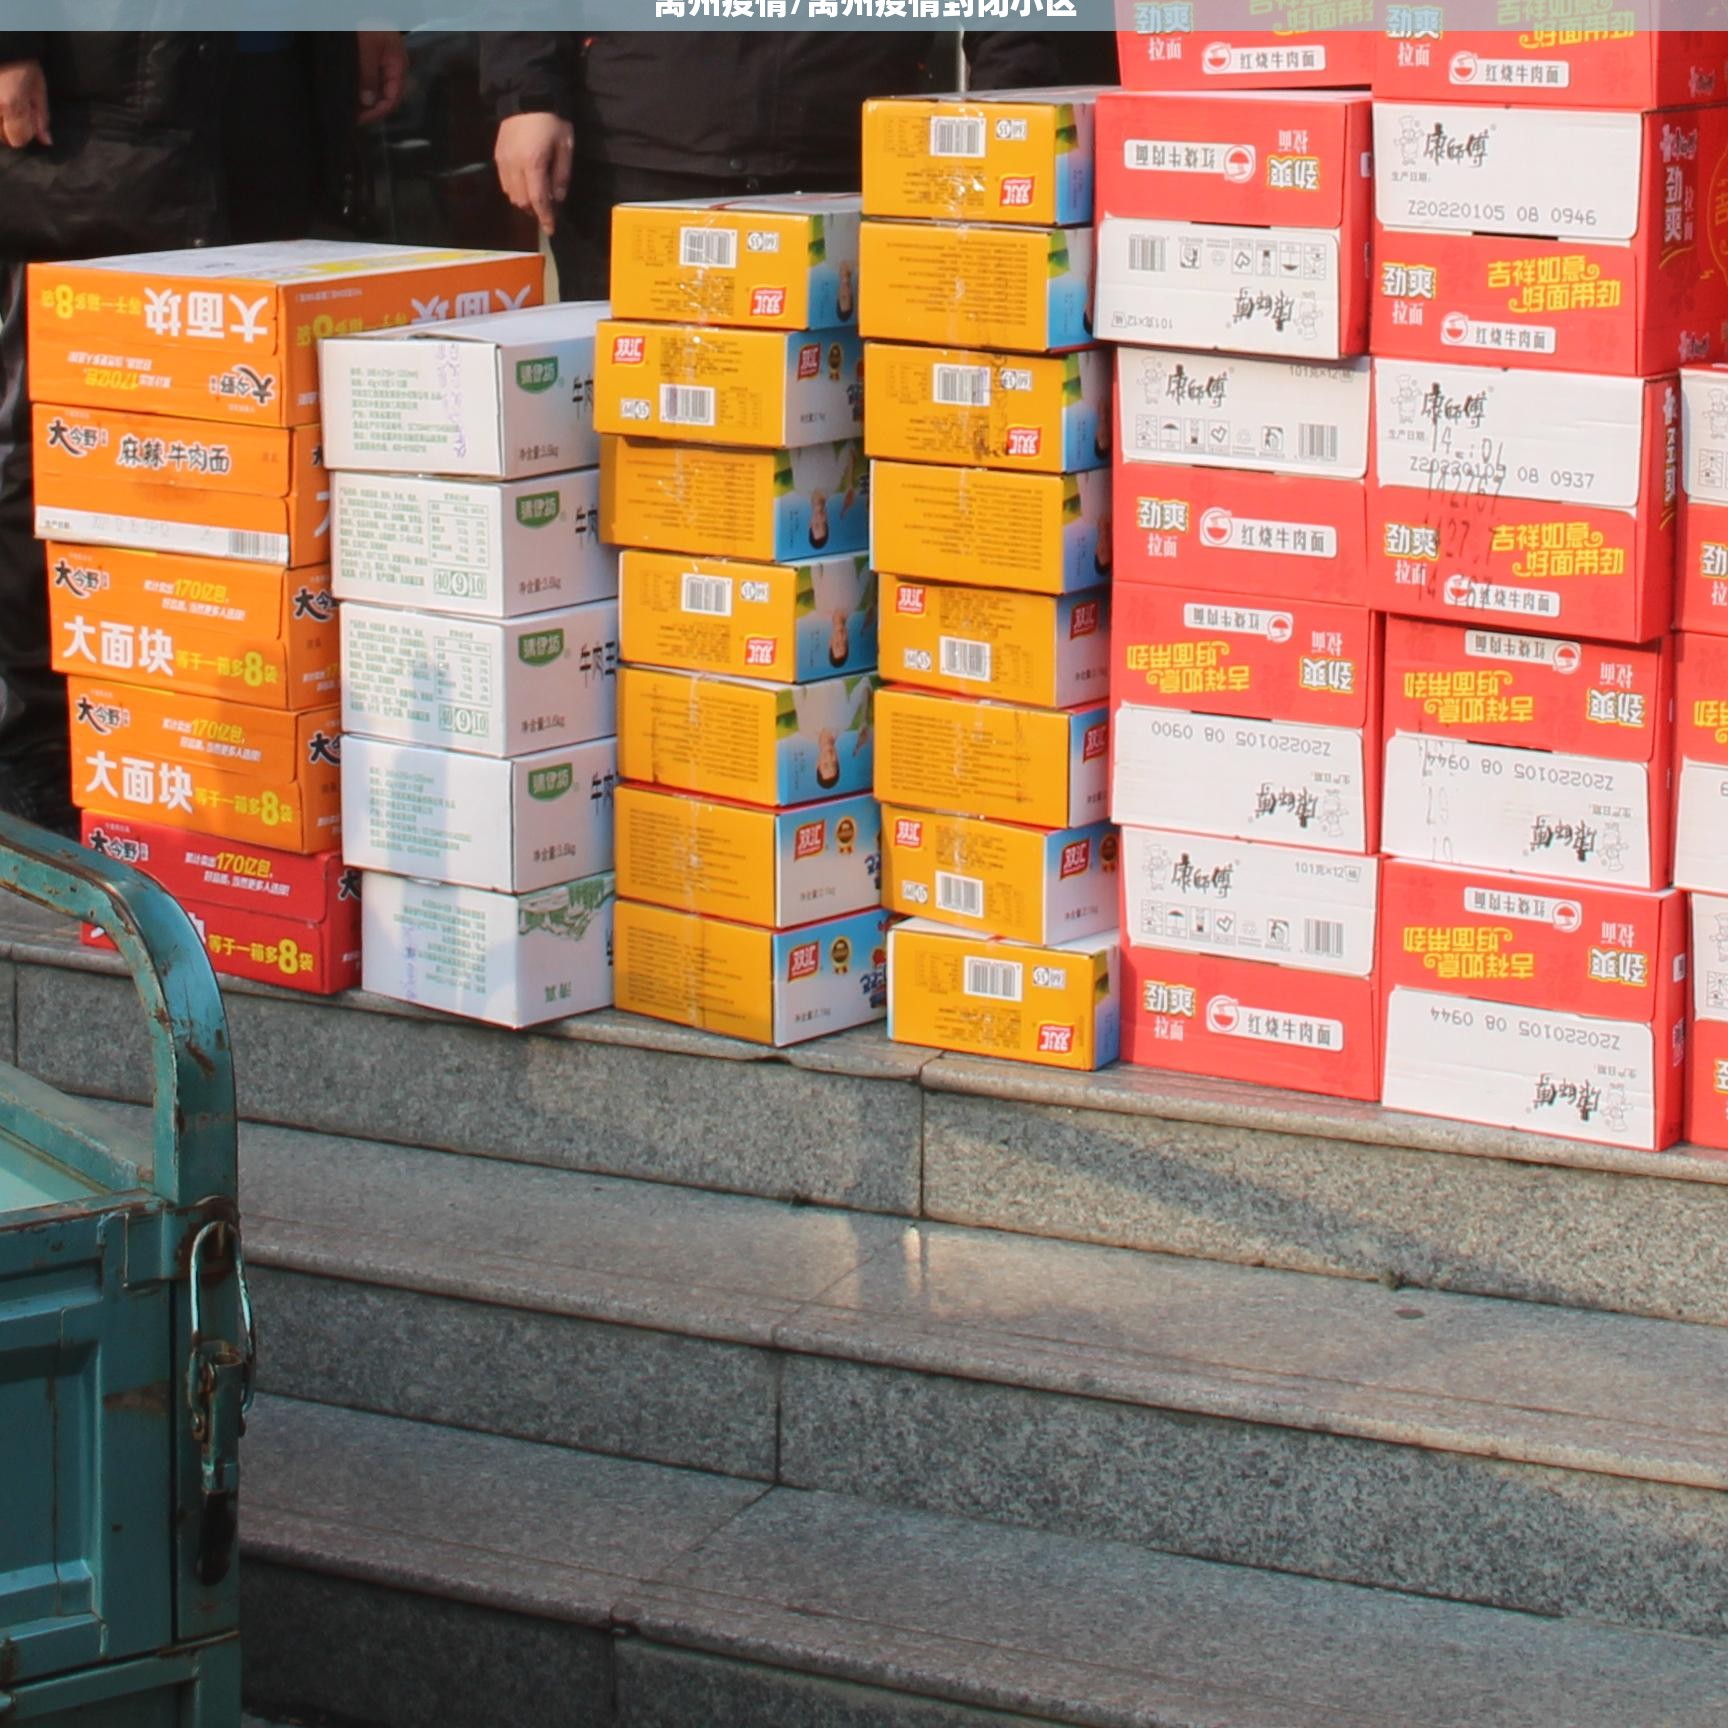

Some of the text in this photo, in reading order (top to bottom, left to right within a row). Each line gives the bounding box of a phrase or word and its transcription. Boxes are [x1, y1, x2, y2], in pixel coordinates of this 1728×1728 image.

[1134, 0, 1193, 34] 劲爽
[1386, 4, 1442, 39] 劲爽
[1519, 11, 1634, 49] 好面带劲
[1148, 37, 1182, 61] 拉面
[1240, 50, 1315, 70] 红烧牛肉面
[1398, 42, 1431, 67] 拉面
[1485, 62, 1559, 85] 红烧牛肉面
[1278, 129, 1308, 152] 拉面
[1135, 144, 1215, 167] 红烧牛肉面
[1268, 155, 1320, 191] 劲爽
[1408, 199, 1597, 226] Z20220105 08 0946
[1381, 262, 1437, 299] 劲爽
[1487, 255, 1600, 287] 吉祥如意
[1508, 280, 1621, 313] 好面带劲
[144, 287, 269, 343] 大面块
[1392, 301, 1423, 326] 拉面
[1475, 325, 1546, 351] 红烧牛肉面
[118, 434, 230, 473] 麻辣牛肉面
[1518, 467, 1539, 484] 08
[1550, 470, 1594, 489] 0937
[1137, 497, 1189, 532] 劲爽
[1147, 535, 1178, 558] 拉面
[1240, 524, 1325, 553] 红烧牛肉面
[1384, 522, 1439, 561] 劲爽
[1491, 522, 1603, 552] 吉祥如意
[1512, 547, 1624, 577] 好面带劲
[1193, 607, 1260, 631] 红烧牛肉面
[63, 615, 176, 677] 大面块
[1127, 641, 1230, 670] 好面带劲
[1312, 631, 1342, 656] 拉面
[1475, 633, 1546, 660] 红烧牛肉面
[1146, 666, 1250, 694] 吉祥如意
[1300, 657, 1354, 694] 劲爽
[1403, 670, 1513, 698] 好面带劲
[1600, 662, 1632, 688] 拉面
[1424, 695, 1534, 724] 吉祥如意
[1587, 687, 1645, 727] 劲爽
[1152, 720, 1331, 757] Z20220105 08 0900
[1480, 758, 1503, 774] 08
[1514, 762, 1614, 791] Z20220105
[85, 751, 193, 814] 大面块
[1474, 891, 1546, 918] 红烧牛肉面
[1403, 927, 1513, 952] 好面带劲
[1601, 921, 1635, 947] 拉面
[1423, 952, 1534, 979] 吉祥如意
[1589, 947, 1648, 987] 劲爽
[1143, 979, 1196, 1017] 劲爽
[1154, 1017, 1184, 1041] 拉面
[1247, 1014, 1331, 1046] 红烧牛肉面
[1430, 1006, 1620, 1050] Z20220105 08 0944
